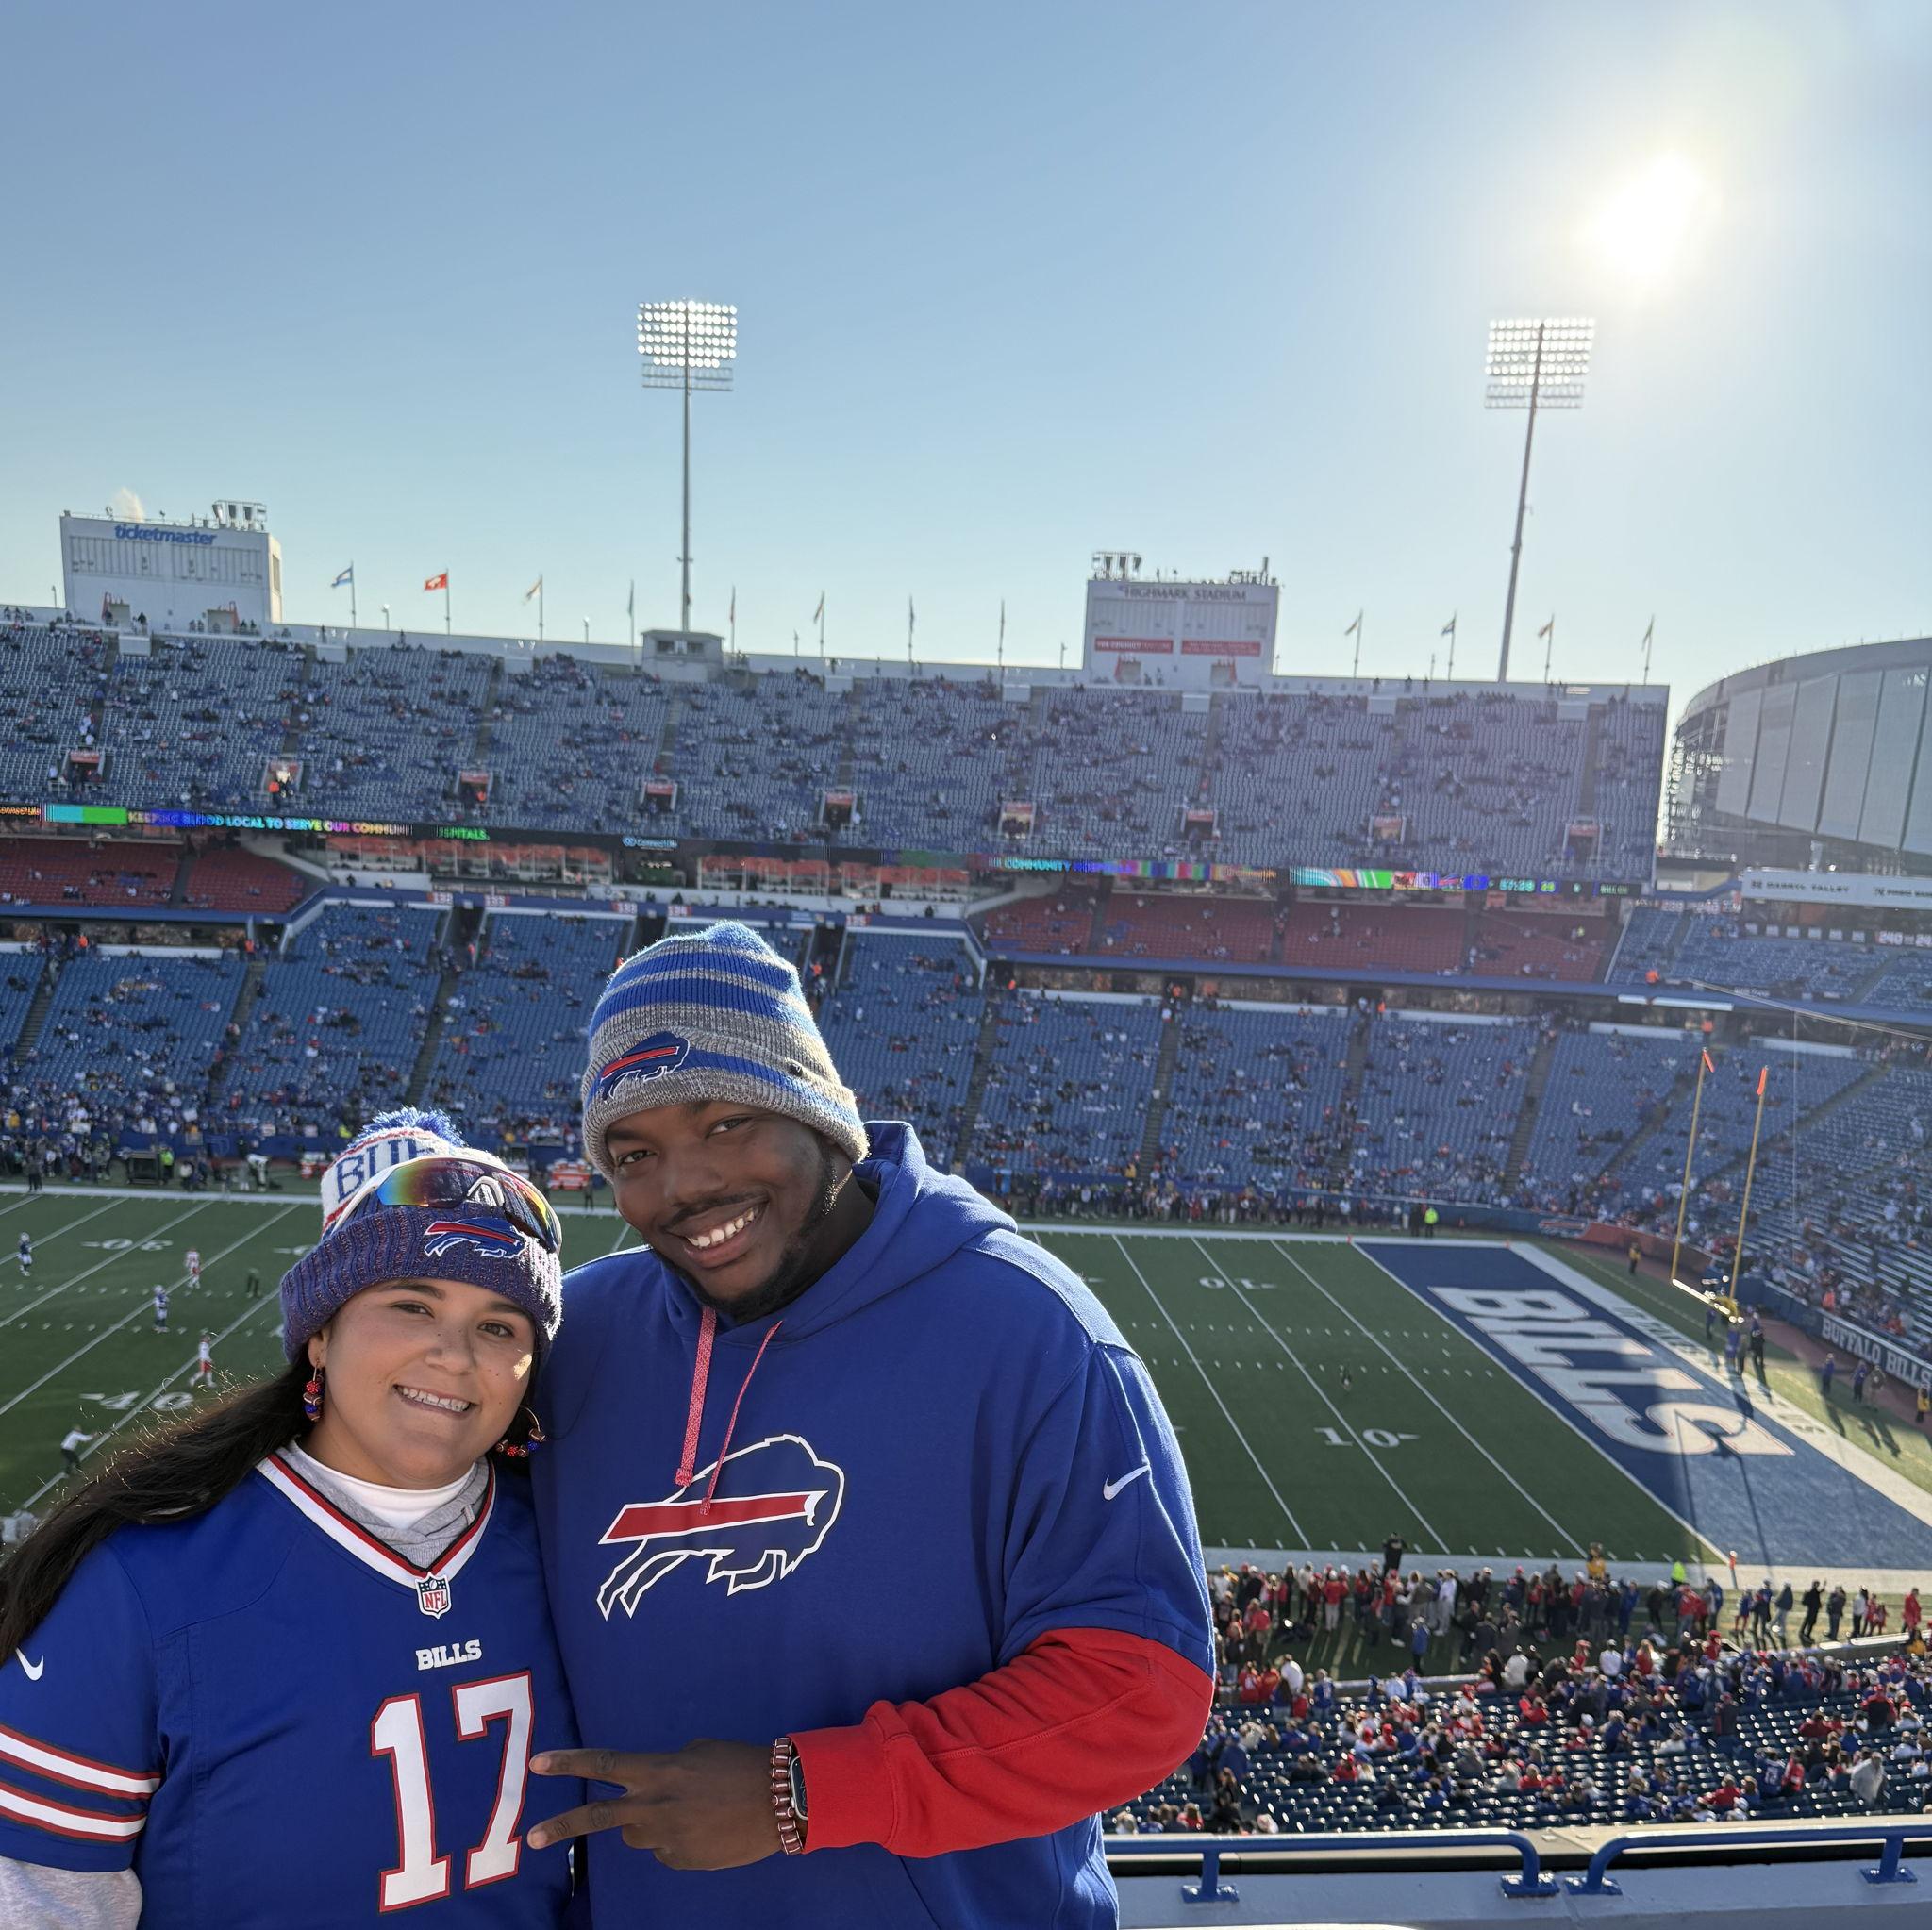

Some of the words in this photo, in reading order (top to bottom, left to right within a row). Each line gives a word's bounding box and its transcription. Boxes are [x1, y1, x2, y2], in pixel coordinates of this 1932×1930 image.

[114, 524, 217, 545] ticketmaster
[1124, 586, 1189, 600] HIGHMARK
[1193, 589, 1246, 602] STADIUM
[226, 814, 265, 829] LOCAL
[266, 816, 283, 830] TO
[285, 817, 322, 831] SERVE
[323, 819, 349, 833] OUR
[1822, 1315, 1882, 1365] BUFFALO
[1885, 1350, 1932, 1390] BILLS
[1427, 1286, 1796, 1456] BILLS
[100, 1390, 194, 1411] 40
[1314, 1425, 1402, 1448] 10
[423, 1589, 447, 1611] NFL
[415, 1639, 482, 1671] BILLS
[370, 1670, 535, 1913] 17
